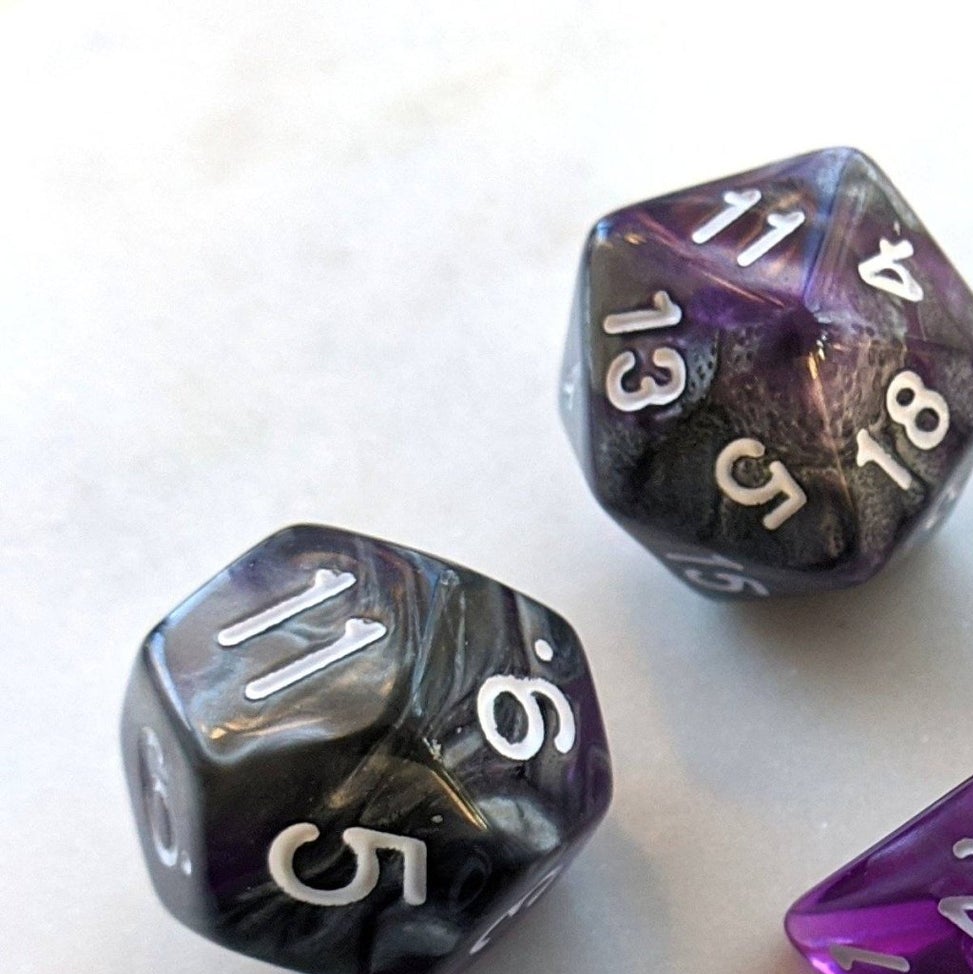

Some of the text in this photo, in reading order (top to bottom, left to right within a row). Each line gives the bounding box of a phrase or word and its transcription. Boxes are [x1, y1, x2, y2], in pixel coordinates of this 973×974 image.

[691, 188, 805, 268] 11
[857, 237, 924, 302] 4
[603, 290, 687, 412] 13
[855, 370, 950, 491] 18
[715, 437, 808, 532] 5
[217, 568, 387, 700] 11
[268, 822, 427, 906] 5
[829, 943, 911, 974] 1
